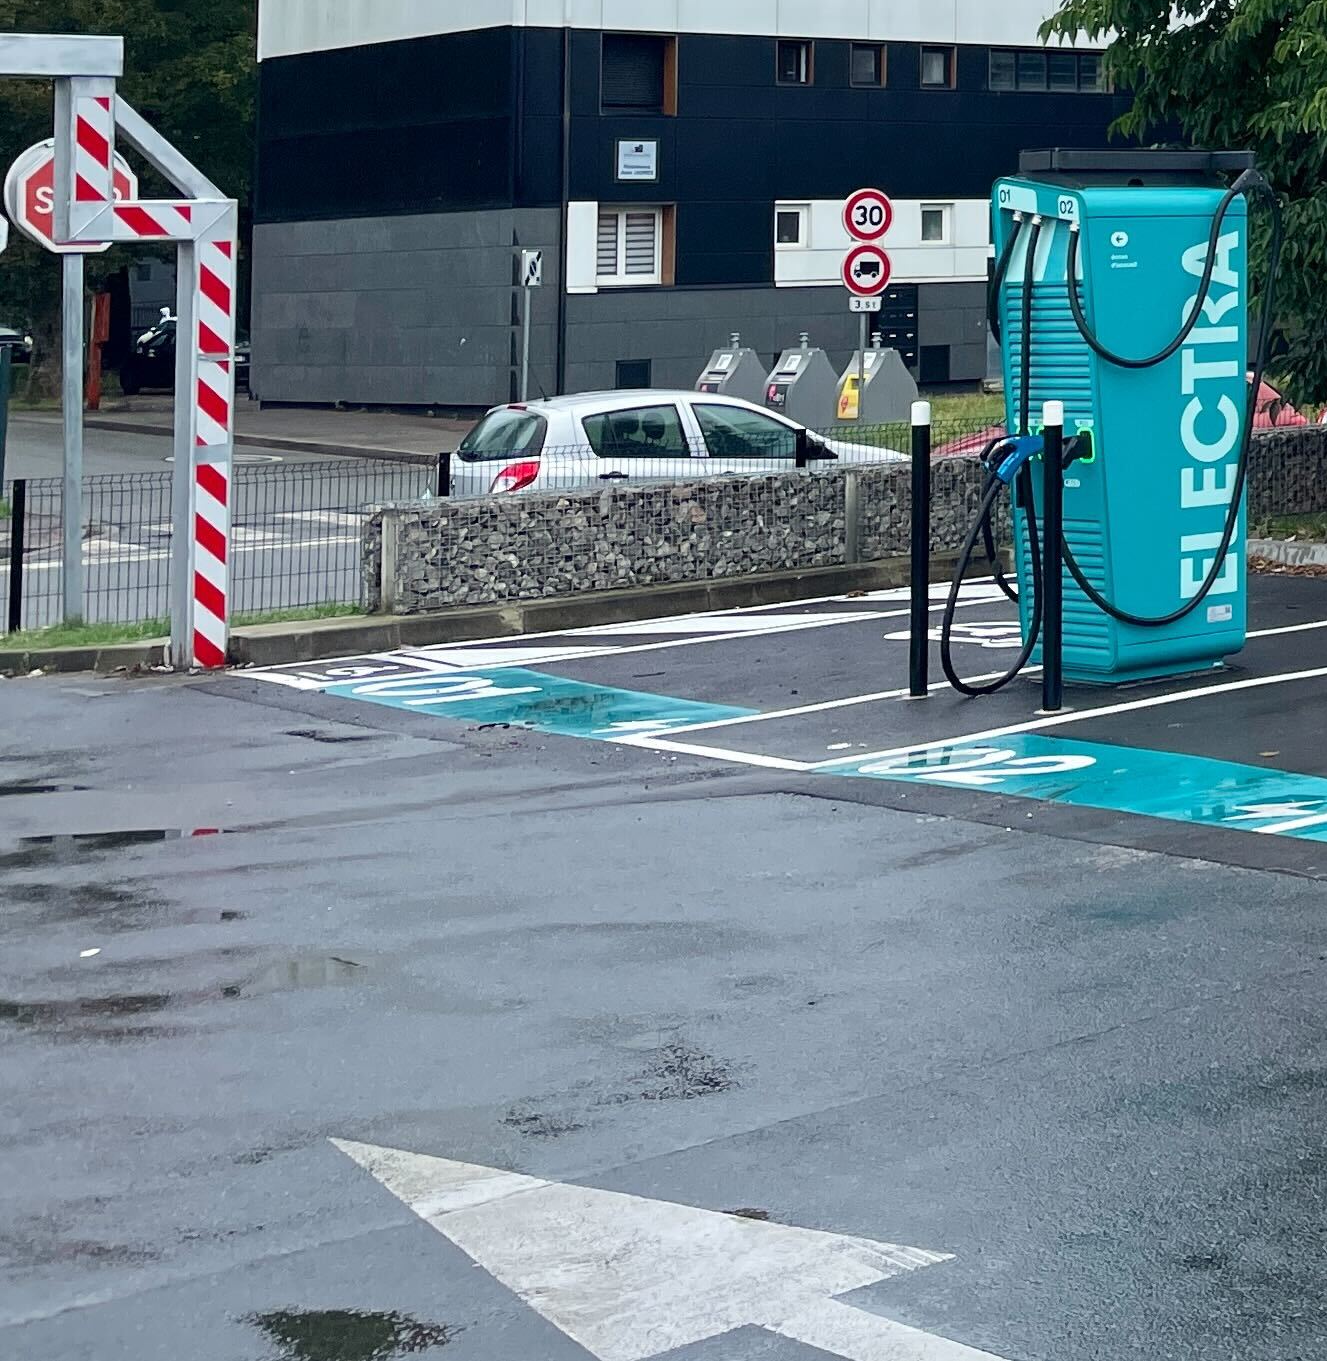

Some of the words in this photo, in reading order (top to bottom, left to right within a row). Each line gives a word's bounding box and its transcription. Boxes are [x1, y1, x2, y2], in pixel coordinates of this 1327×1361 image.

[999, 189, 1011, 203] 01
[855, 205, 884, 226] 30
[1059, 200, 1074, 214] 02
[1180, 230, 1240, 600] ELECTRA
[857, 747, 1097, 785] 02
